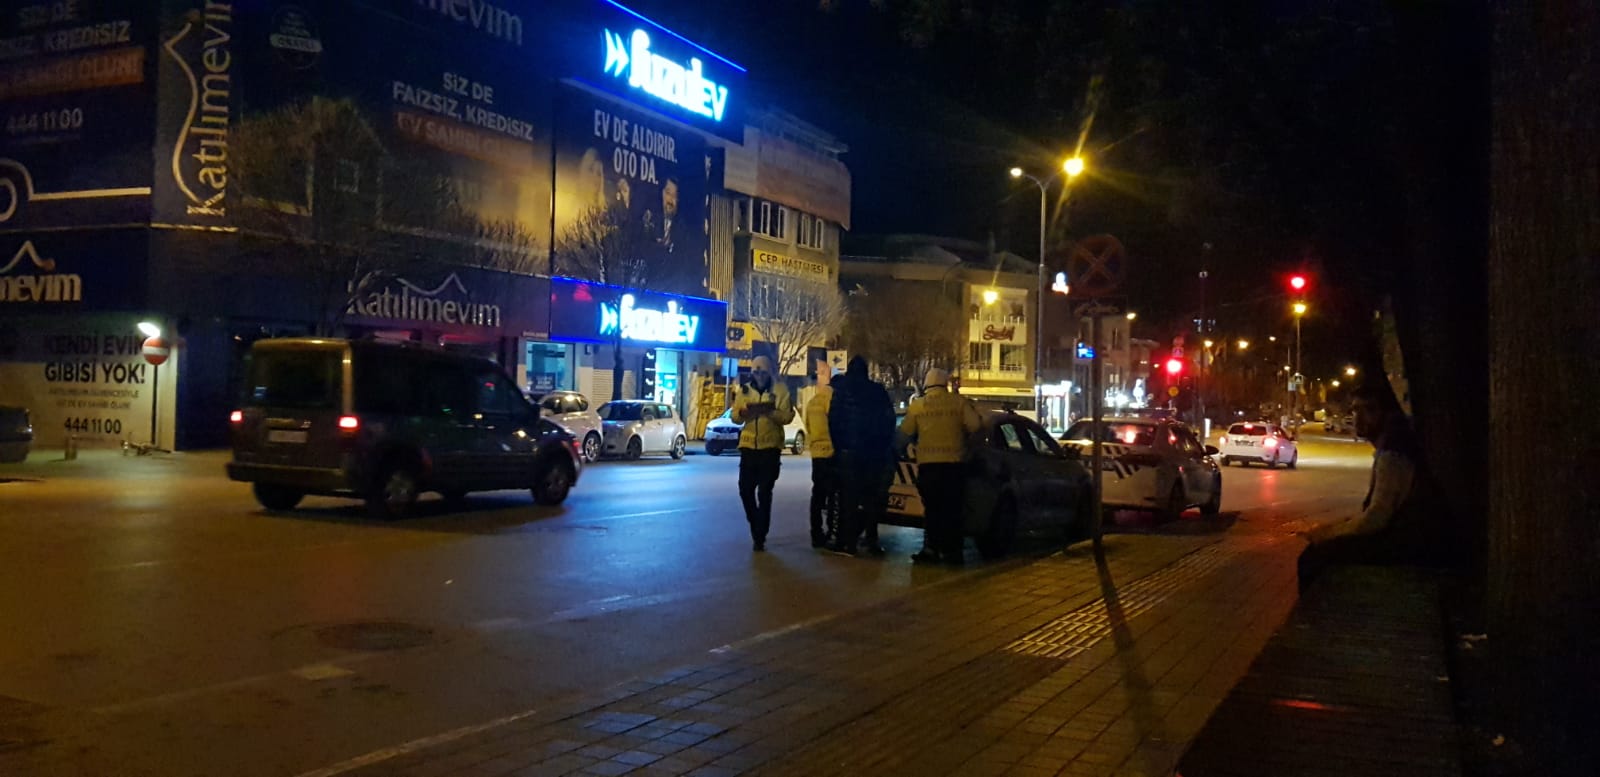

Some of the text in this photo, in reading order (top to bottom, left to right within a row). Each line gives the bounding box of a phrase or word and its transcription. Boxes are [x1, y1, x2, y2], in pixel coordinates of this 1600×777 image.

[471, 82, 494, 105] DE
[59, 107, 84, 129] 00
[594, 108, 679, 164] EV DE ALDIRIR.
[613, 146, 660, 186] OTO DA.
[759, 252, 778, 265] CEP
[102, 362, 146, 384] YOK!
[64, 417, 122, 434] 444 11 00
